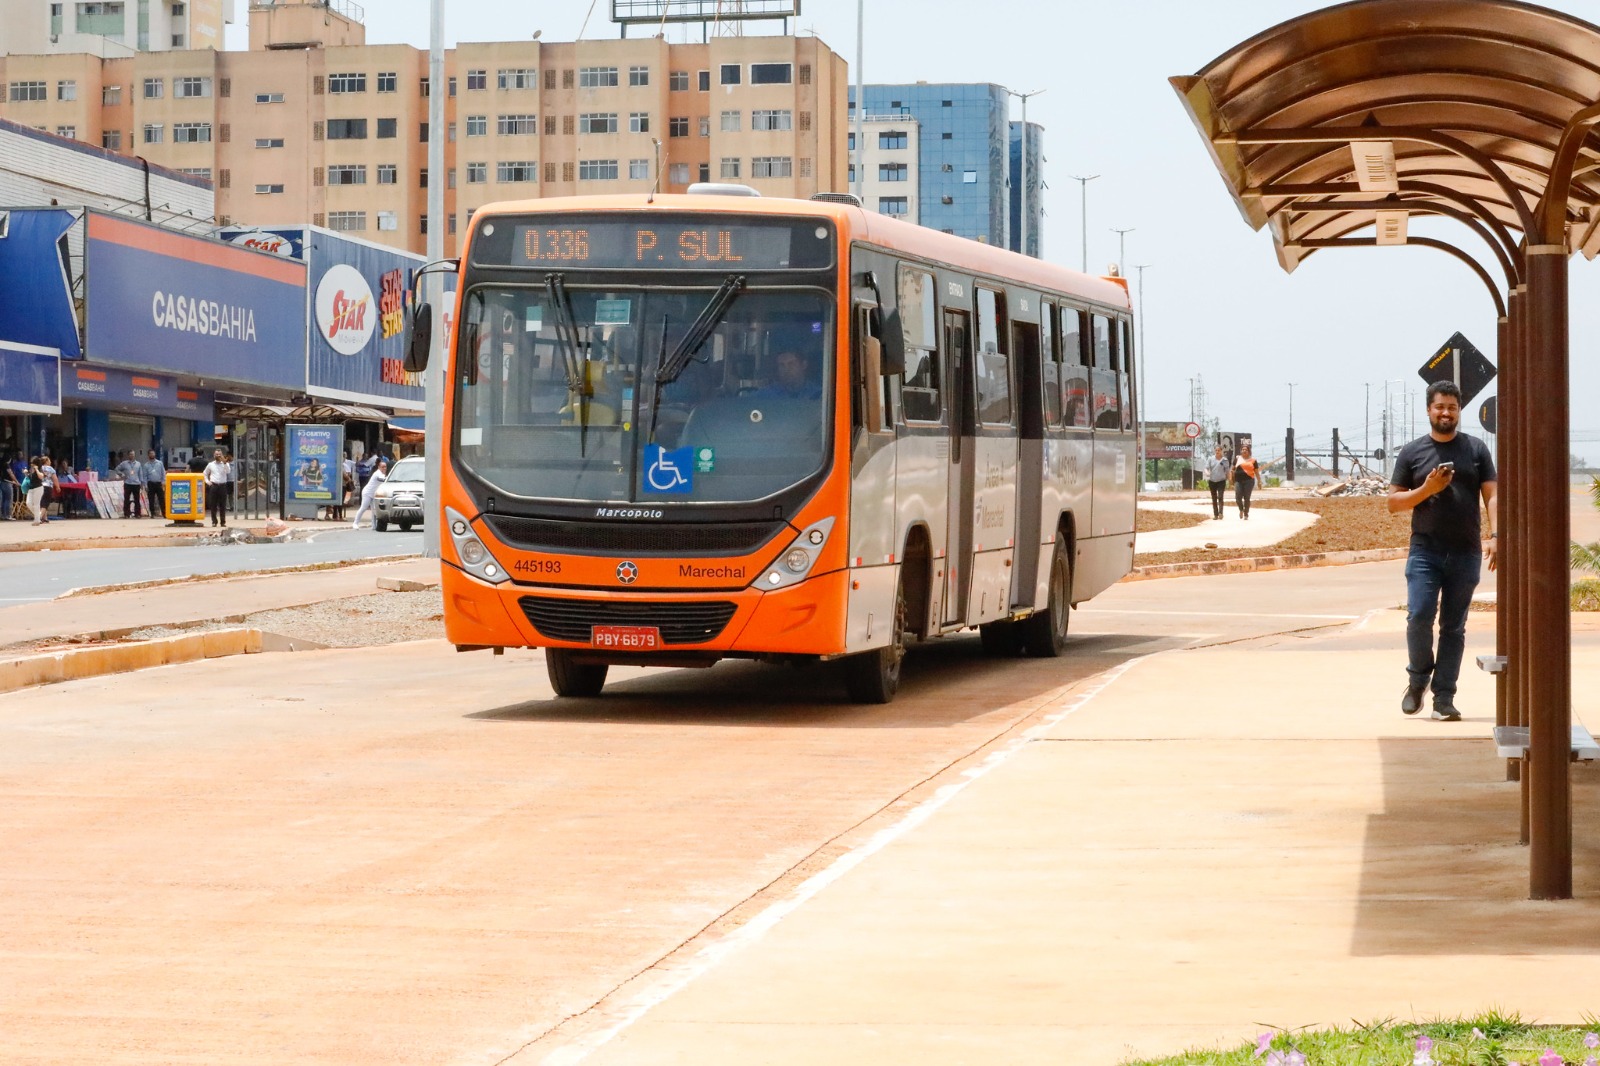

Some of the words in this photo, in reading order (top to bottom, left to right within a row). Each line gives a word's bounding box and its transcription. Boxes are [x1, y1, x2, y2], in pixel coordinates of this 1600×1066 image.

[525, 230, 589, 260] 0.336
[636, 230, 664, 261] P.
[679, 231, 743, 261] SUL
[329, 289, 367, 339] STAR
[382, 308, 404, 339] STAR
[596, 508, 662, 518] Marcopolo
[513, 560, 562, 573] 445193
[679, 564, 746, 578] Marechal
[596, 633, 655, 647] PBY-6879
